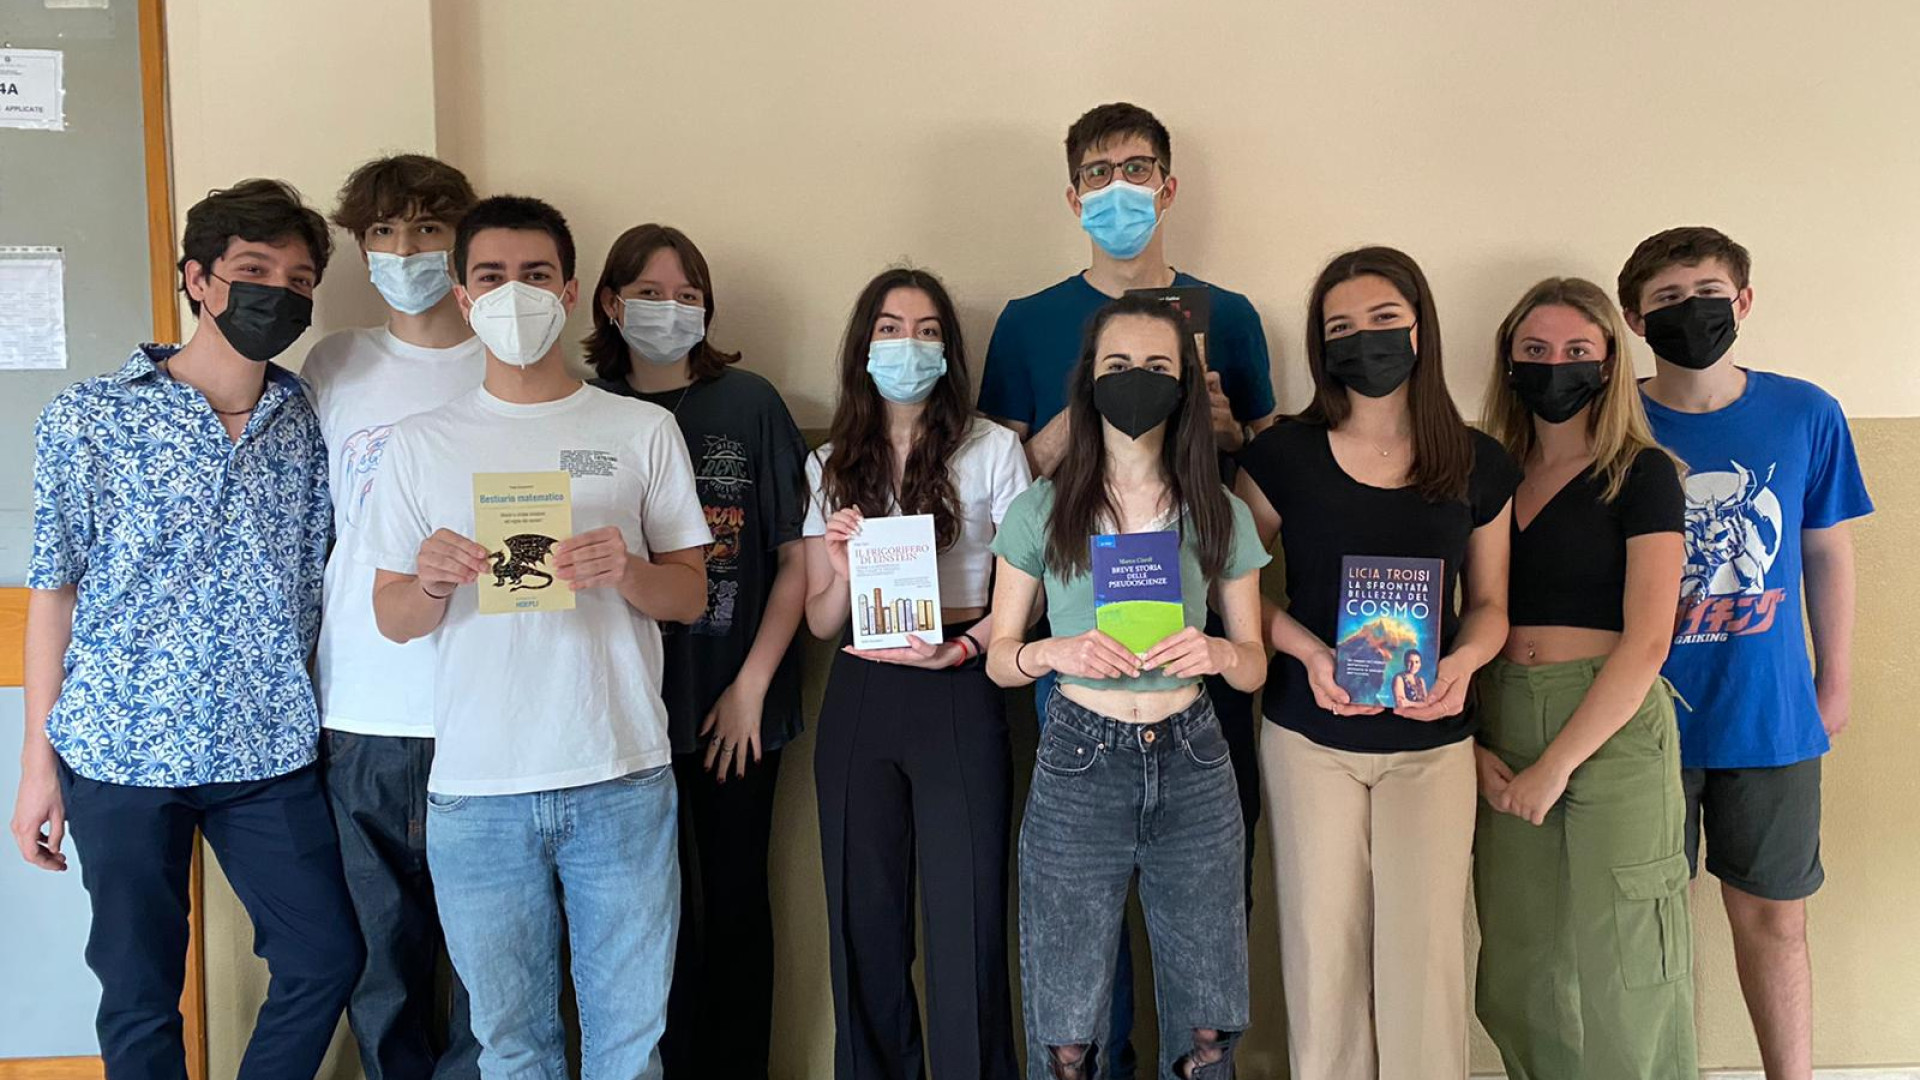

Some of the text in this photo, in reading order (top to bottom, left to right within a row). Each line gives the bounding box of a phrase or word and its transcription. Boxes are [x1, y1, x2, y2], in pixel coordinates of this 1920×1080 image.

[5, 105, 43, 113] APPLICATE
[480, 492, 565, 503] Bestiario matematico
[855, 549, 865, 558] IL
[866, 544, 930, 558] FRIGORIFERO
[860, 553, 917, 565] DI EINSTEIN
[1111, 564, 1162, 574] BREVE STORIA
[1348, 567, 1430, 582] LICIA TROISI
[1126, 572, 1147, 580] DELLE
[1108, 577, 1168, 589] PSEUDOSCIENZE
[1348, 580, 1429, 592] LA SFRONTATA
[1347, 590, 1429, 602] BELLEZZA DEL
[1346, 599, 1430, 620] COSMO
[1673, 633, 1728, 645] GAIKING
